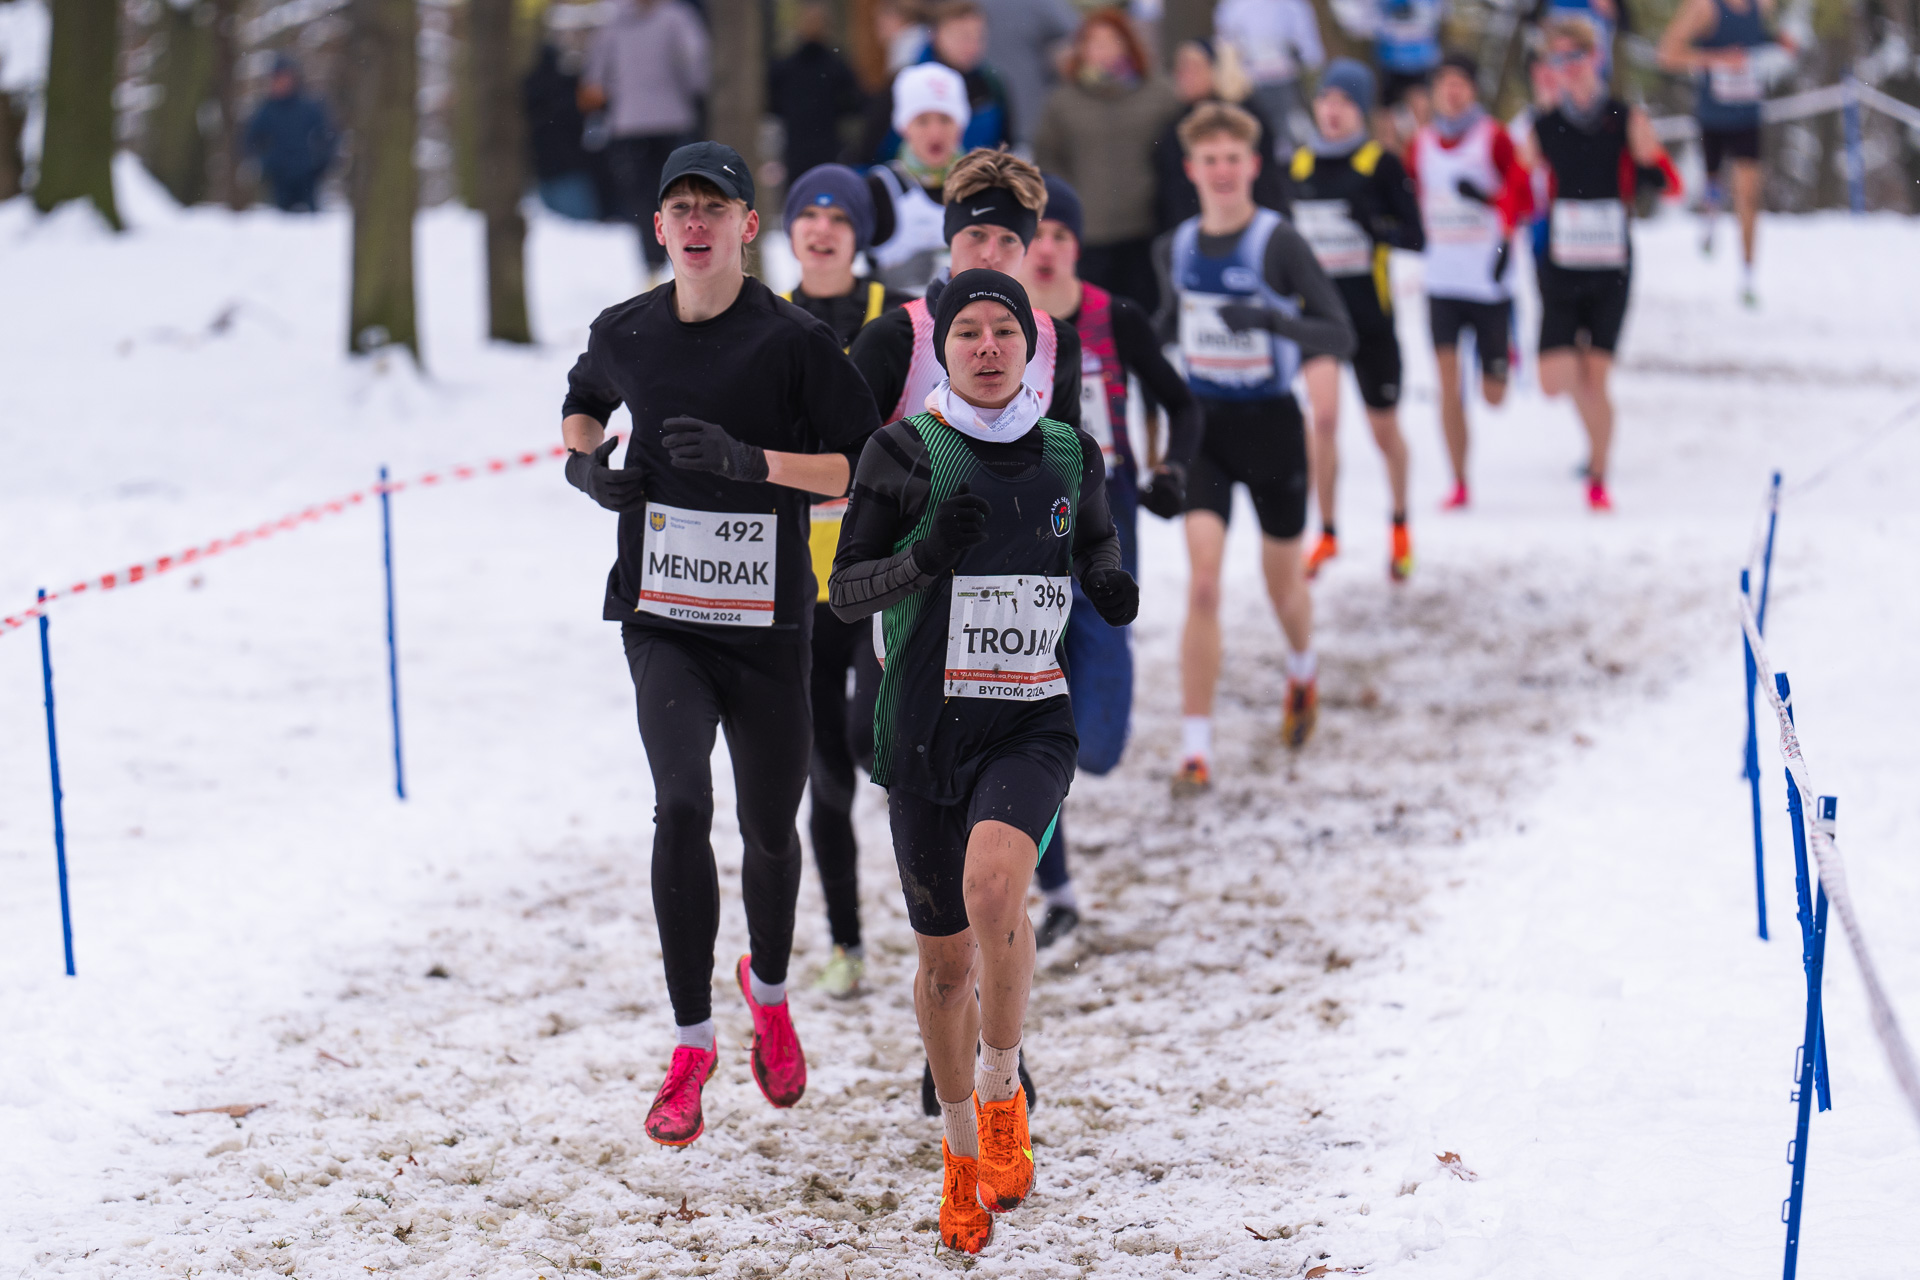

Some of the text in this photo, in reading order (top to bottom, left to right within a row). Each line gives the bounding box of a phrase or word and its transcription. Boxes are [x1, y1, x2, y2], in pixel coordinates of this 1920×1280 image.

[714, 521, 764, 542] 492
[648, 551, 769, 586] MENDRAK
[1033, 584, 1066, 608] 396
[669, 607, 742, 623] BYTOM 2024
[978, 685, 1045, 698] BYTOM 224
